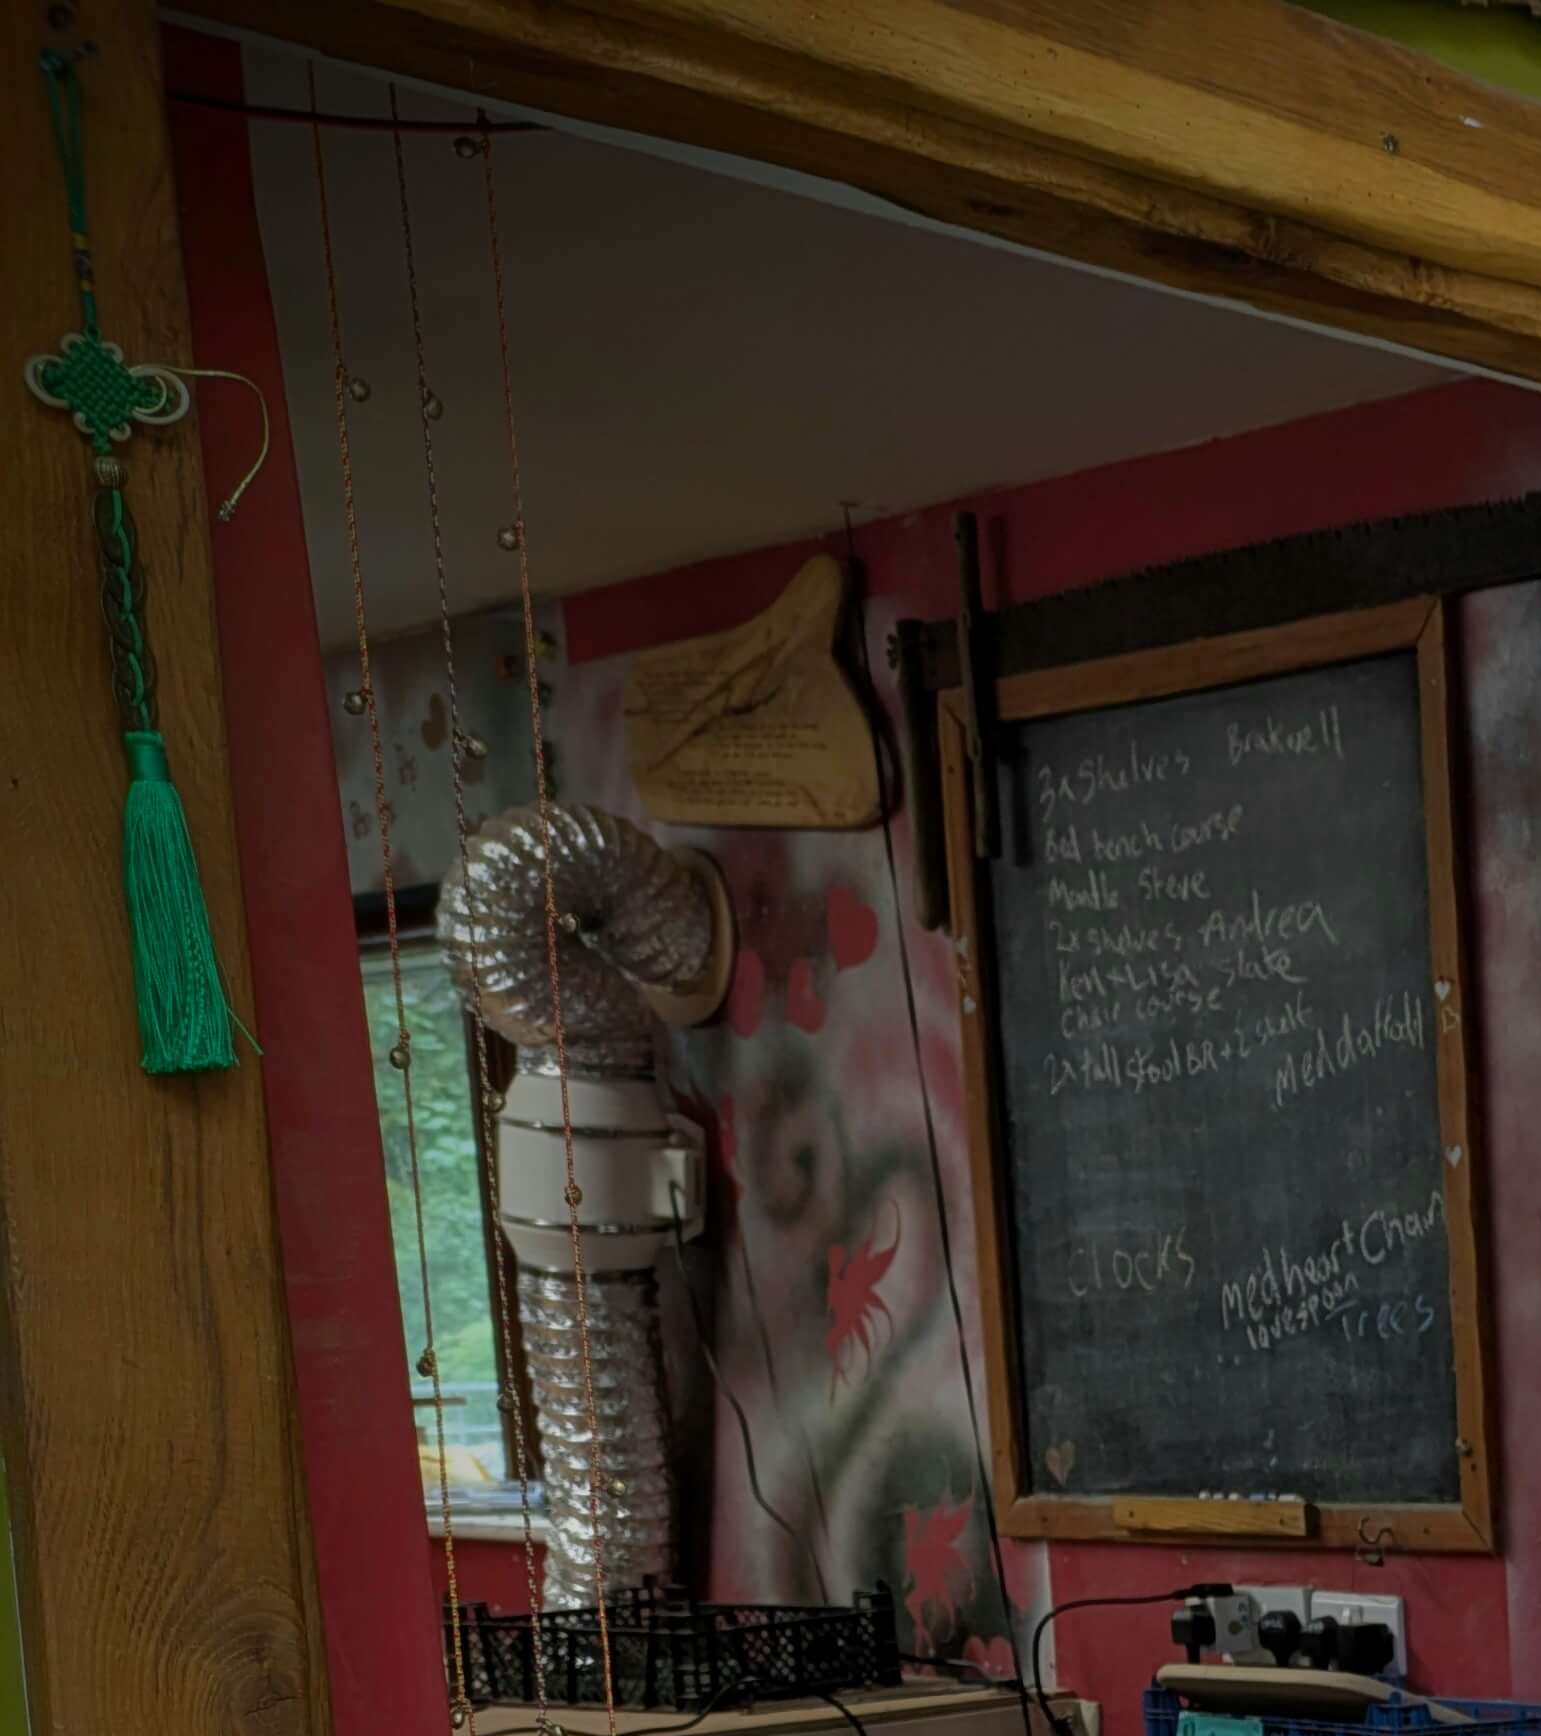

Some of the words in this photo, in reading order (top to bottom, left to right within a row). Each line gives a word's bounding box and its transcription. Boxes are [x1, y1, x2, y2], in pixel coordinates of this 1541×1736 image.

[1137, 866, 1212, 902] Steve
[1200, 887, 1340, 947] Andrea
[1335, 1296, 1434, 1344] Trees
